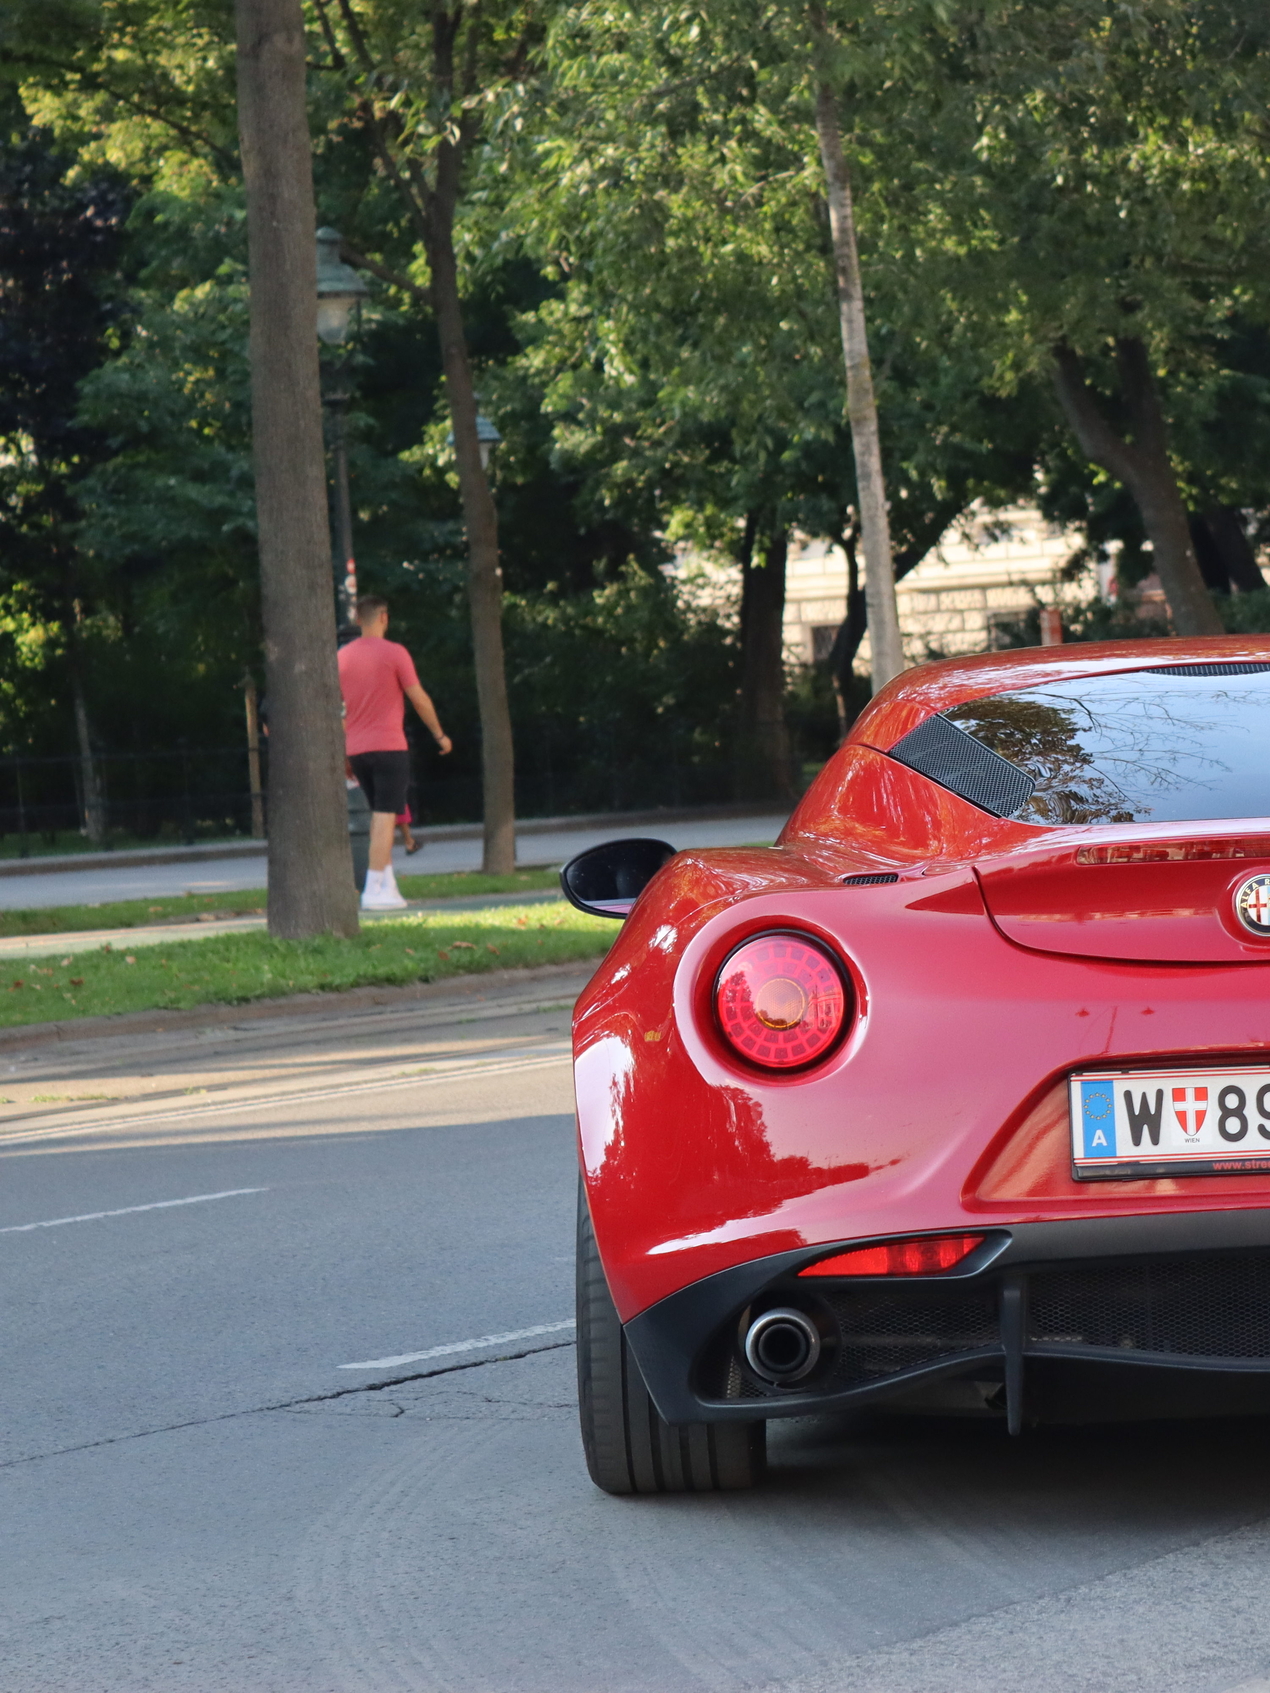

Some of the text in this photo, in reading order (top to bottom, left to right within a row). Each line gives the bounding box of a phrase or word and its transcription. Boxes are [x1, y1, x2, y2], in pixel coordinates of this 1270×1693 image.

[1240, 883, 1259, 908] ALFA
[1123, 1088, 1164, 1147] W
[1091, 1129, 1108, 1147] A
[1183, 1136, 1201, 1144] WIEN
